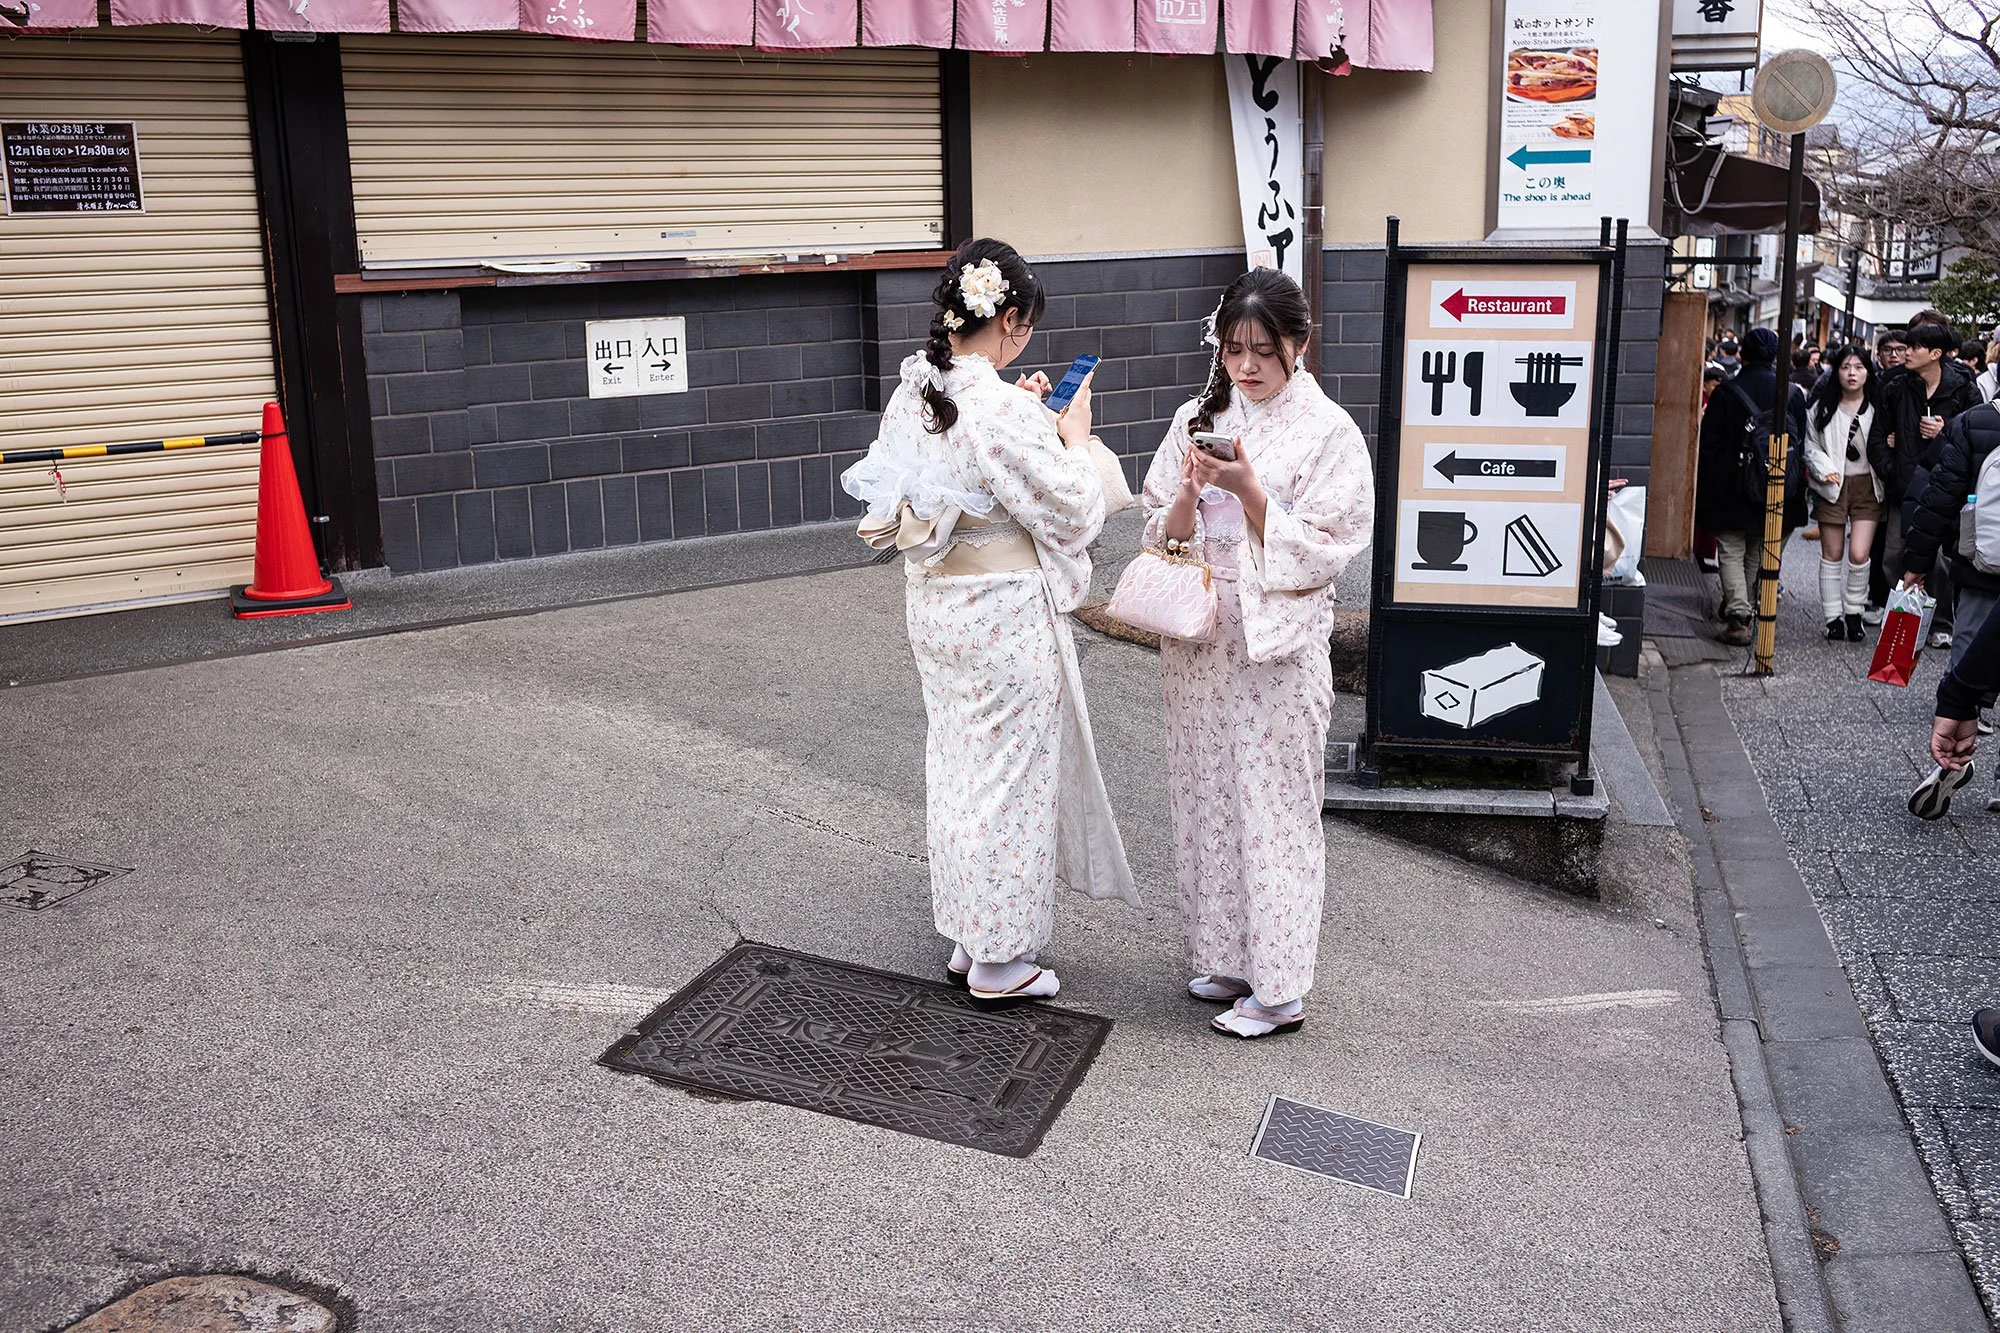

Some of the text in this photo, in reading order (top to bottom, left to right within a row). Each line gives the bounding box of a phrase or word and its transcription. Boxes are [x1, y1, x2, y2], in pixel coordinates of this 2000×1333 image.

[1513, 17, 1594, 29] 京のホットサンド
[27, 124, 105, 134] 休業のお知らせ
[1525, 176, 1566, 189] この奥
[1503, 192, 1591, 203] The shop is ahead
[1468, 299, 1552, 312] Restaurant
[595, 337, 678, 360] 出口 入口
[603, 374, 675, 385] Exit Enter
[1480, 461, 1516, 475] Cafe
